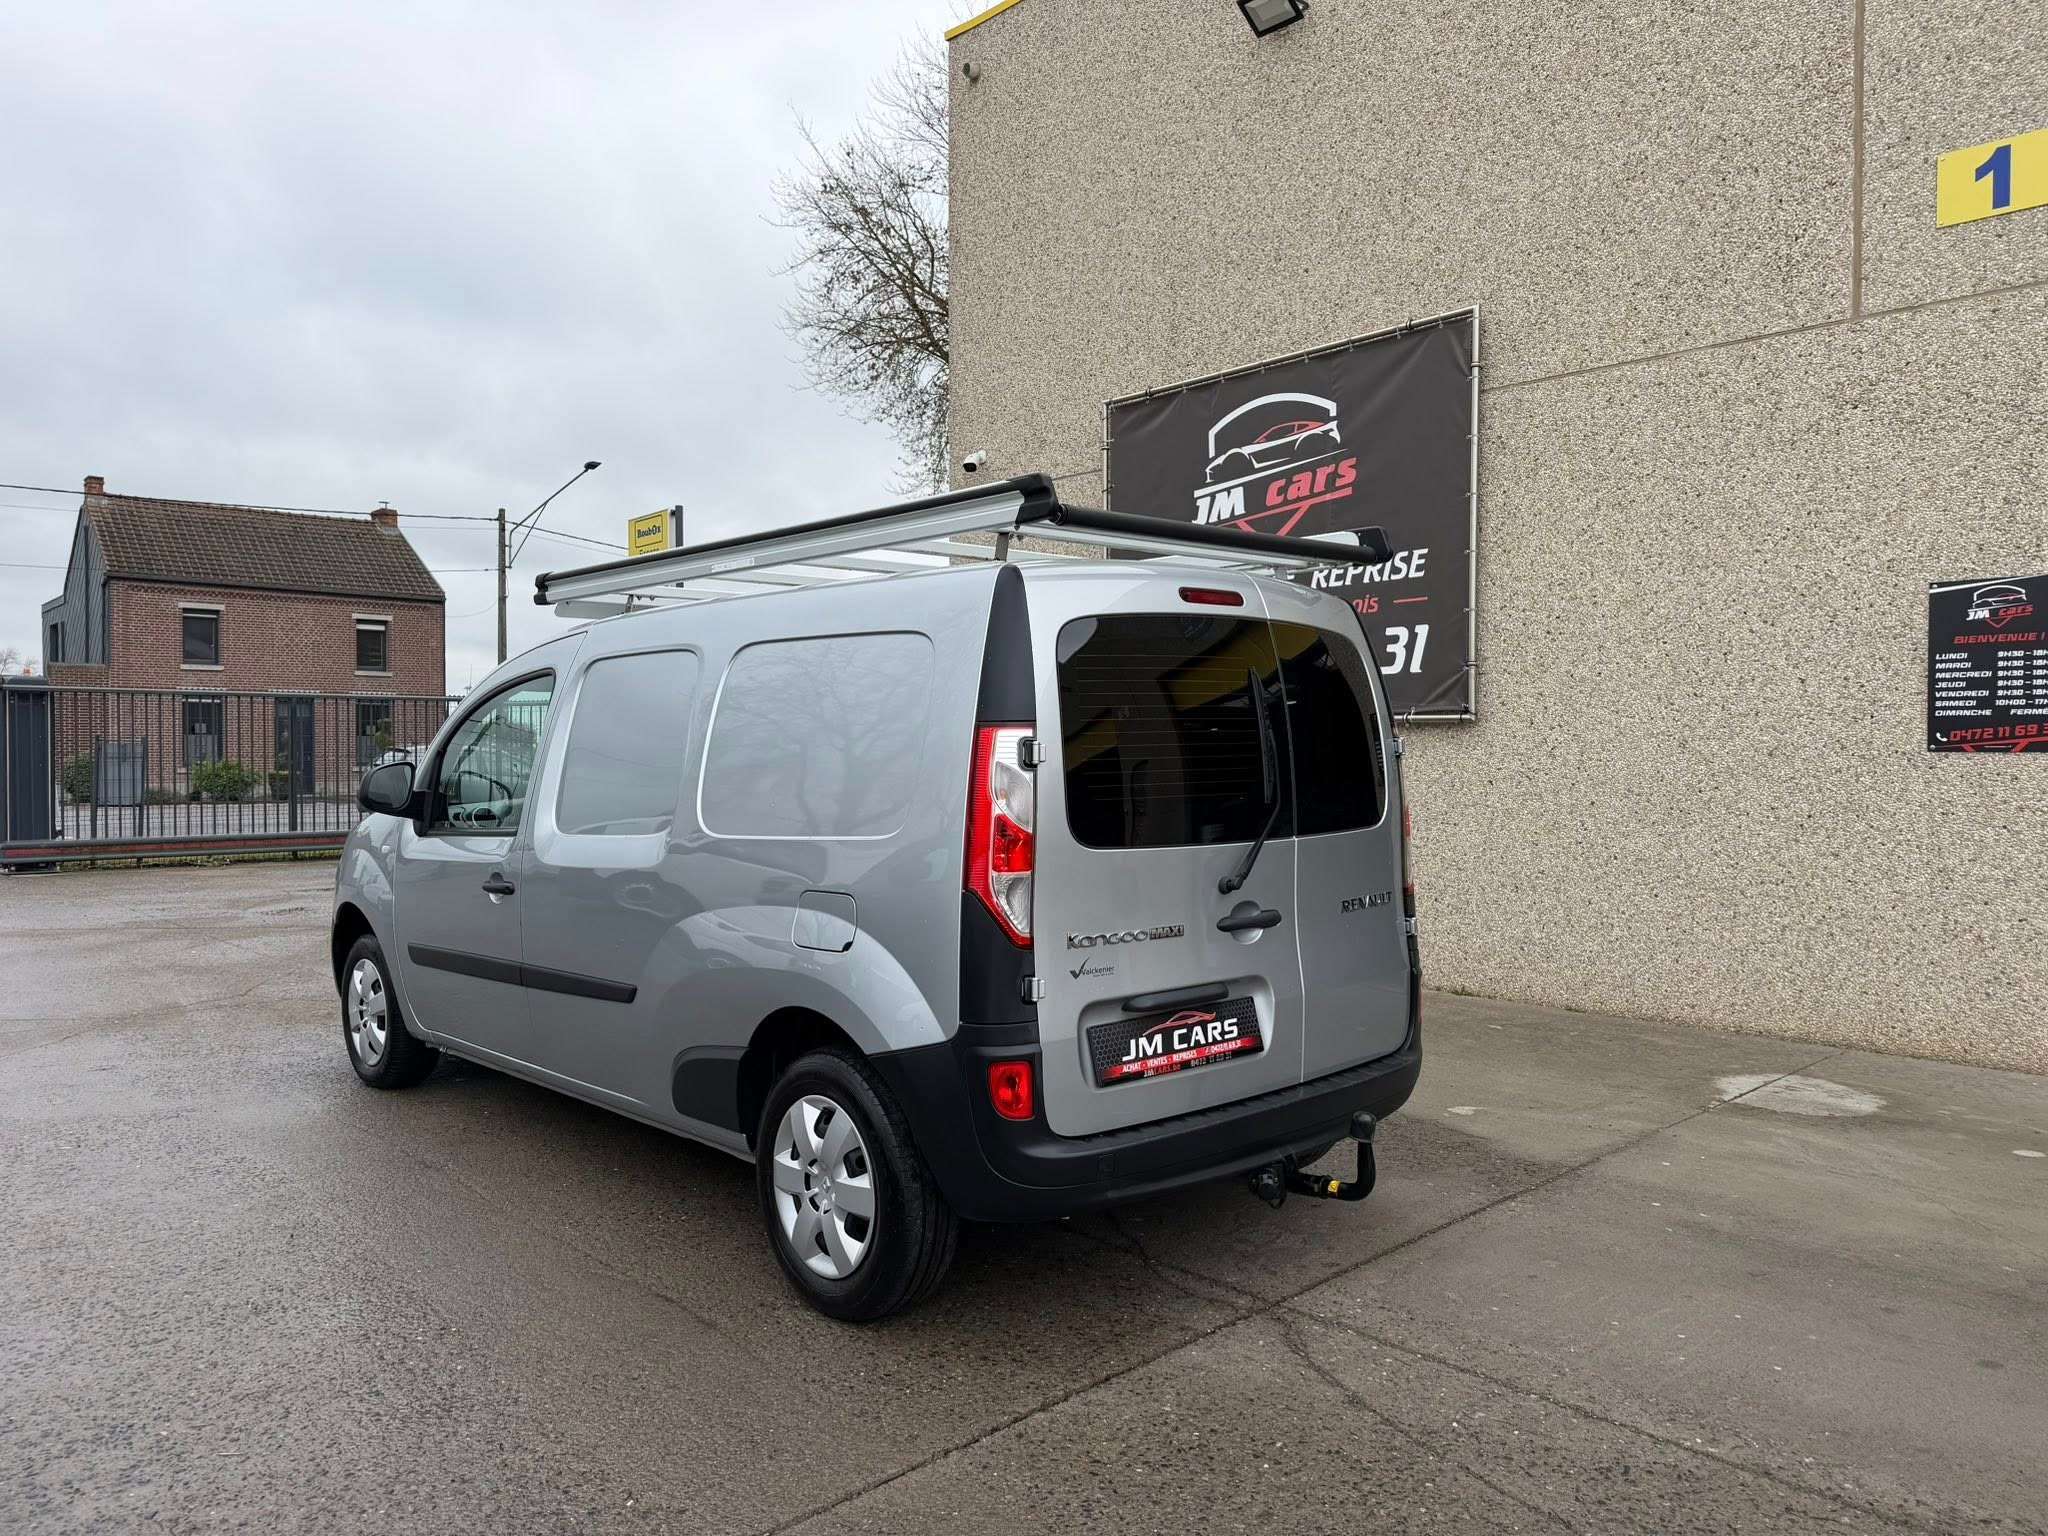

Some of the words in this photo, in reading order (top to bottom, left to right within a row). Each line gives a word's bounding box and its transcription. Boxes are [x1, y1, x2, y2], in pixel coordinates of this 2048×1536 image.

[1975, 144, 2011, 209] 1
[1192, 486, 1246, 525] JM
[1265, 457, 1357, 506] cars
[1311, 548, 1428, 589] REPRISE
[1966, 609, 1990, 621] JM
[1999, 604, 2033, 617] cars
[1953, 632, 2038, 644] BIENVENUE
[1380, 624, 1429, 675] 31
[1935, 652, 1968, 660] LUNDI
[1935, 671, 1992, 679] MERCREDI
[1935, 690, 1989, 698] VENDREDI
[1949, 728, 1993, 741] 0472
[1999, 726, 2010, 737] 11
[2015, 724, 2039, 736] 69
[1341, 891, 1392, 914] RENAULT
[1150, 925, 1184, 940] MAXI
[1122, 1034, 1162, 1062] JM
[1173, 1018, 1238, 1050] CARS
[1122, 1061, 1141, 1073] ACHAT
[1147, 1056, 1168, 1067] VENTES
[1173, 1050, 1198, 1061] REPRISES
